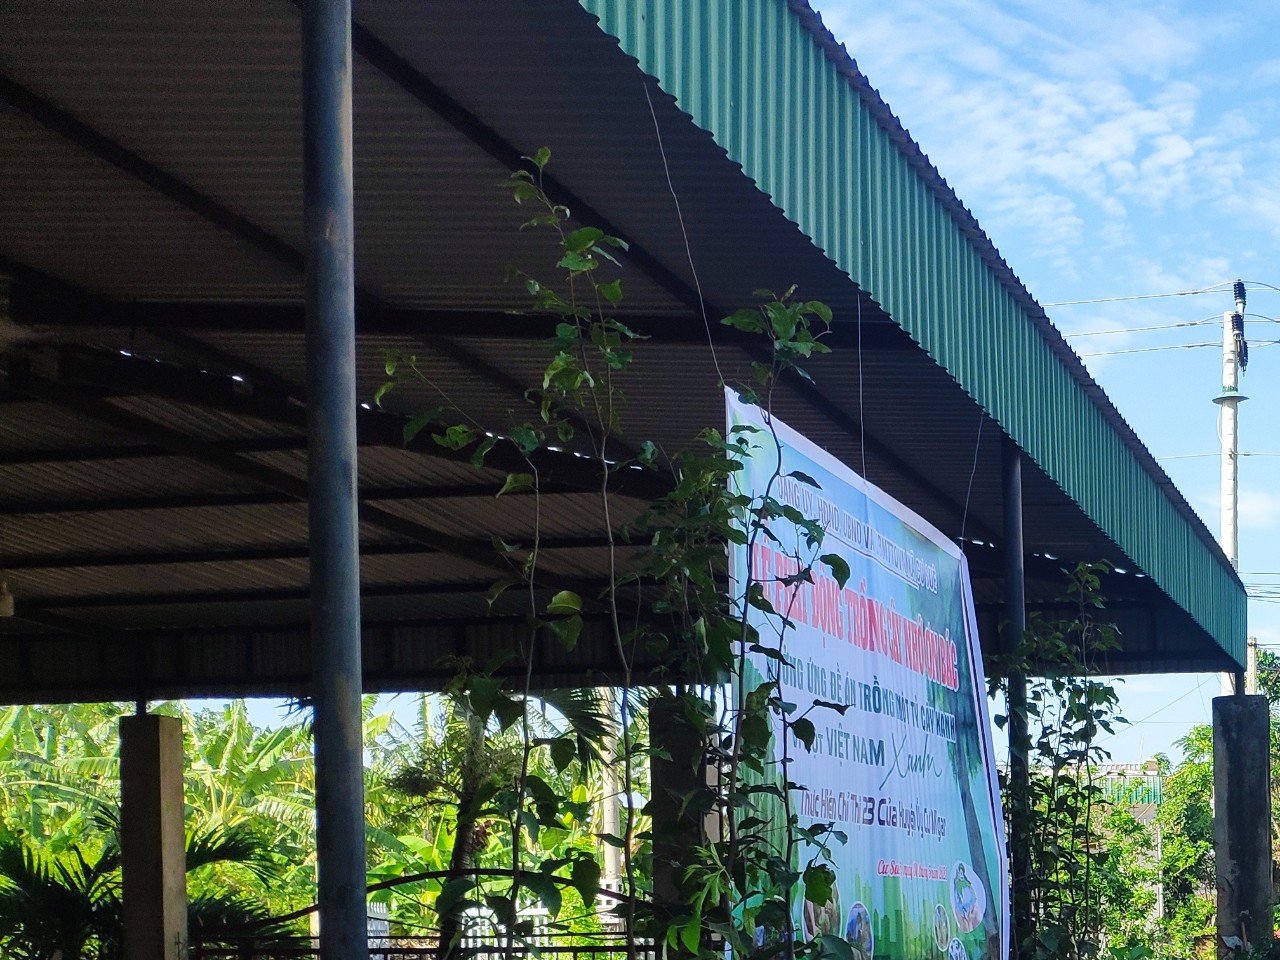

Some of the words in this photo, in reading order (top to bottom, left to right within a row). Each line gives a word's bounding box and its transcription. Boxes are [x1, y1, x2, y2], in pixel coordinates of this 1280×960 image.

[807, 657, 827, 698] ỨNG
[859, 675, 895, 717] TRỒNG
[826, 722, 850, 767] VIỆT
[853, 734, 886, 767] NAM
[878, 731, 943, 791] Xanh
[862, 795, 875, 826] 23
[878, 796, 898, 828] Của
